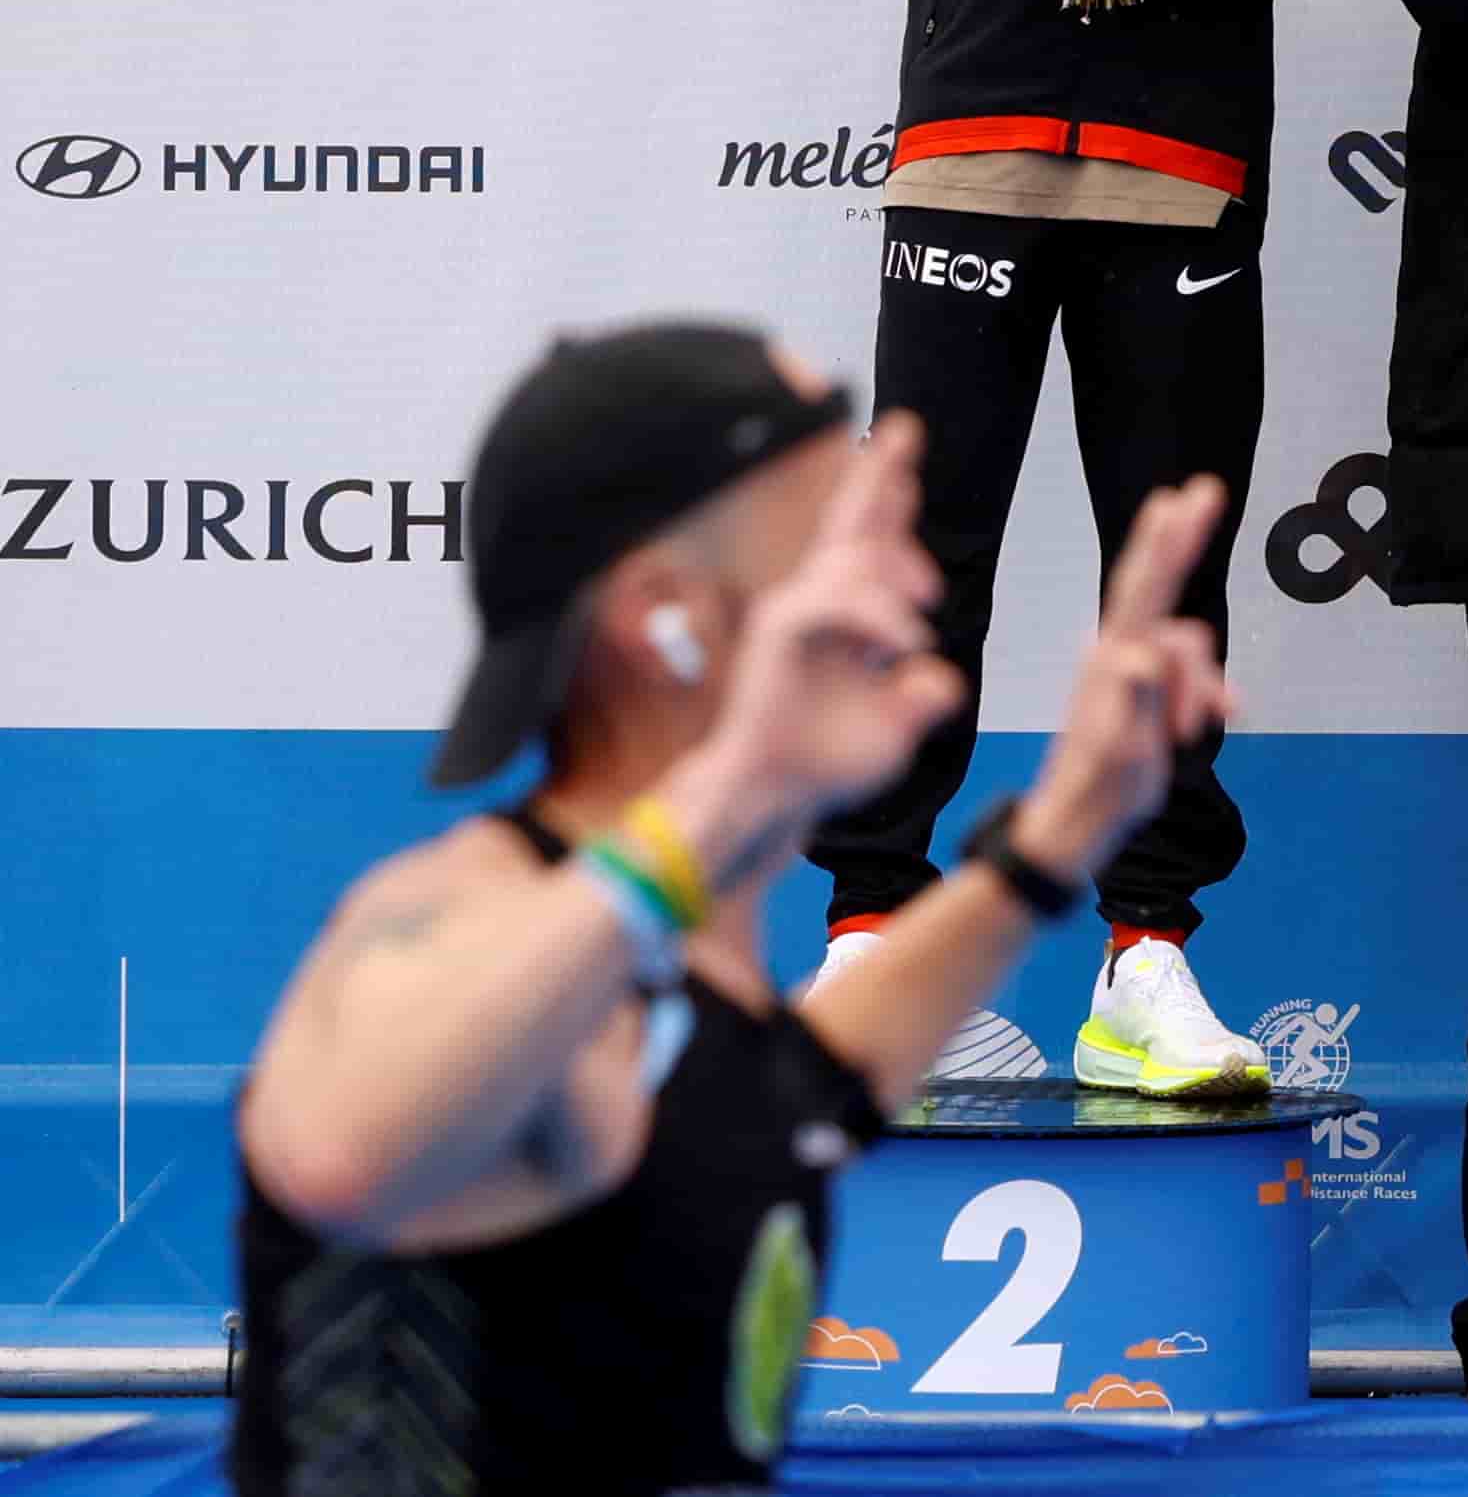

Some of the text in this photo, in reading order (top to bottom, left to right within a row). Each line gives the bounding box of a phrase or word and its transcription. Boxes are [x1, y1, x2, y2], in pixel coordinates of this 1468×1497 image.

[164, 145, 483, 192] HYUNDAI
[883, 239, 1016, 298] INEOS
[0, 478, 467, 564] ZURICH
[1249, 998, 1313, 1038] RUNNING
[1311, 1186, 1417, 1200] istance Races
[1312, 1169, 1407, 1183] nternational
[910, 1180, 1081, 1393] 2
